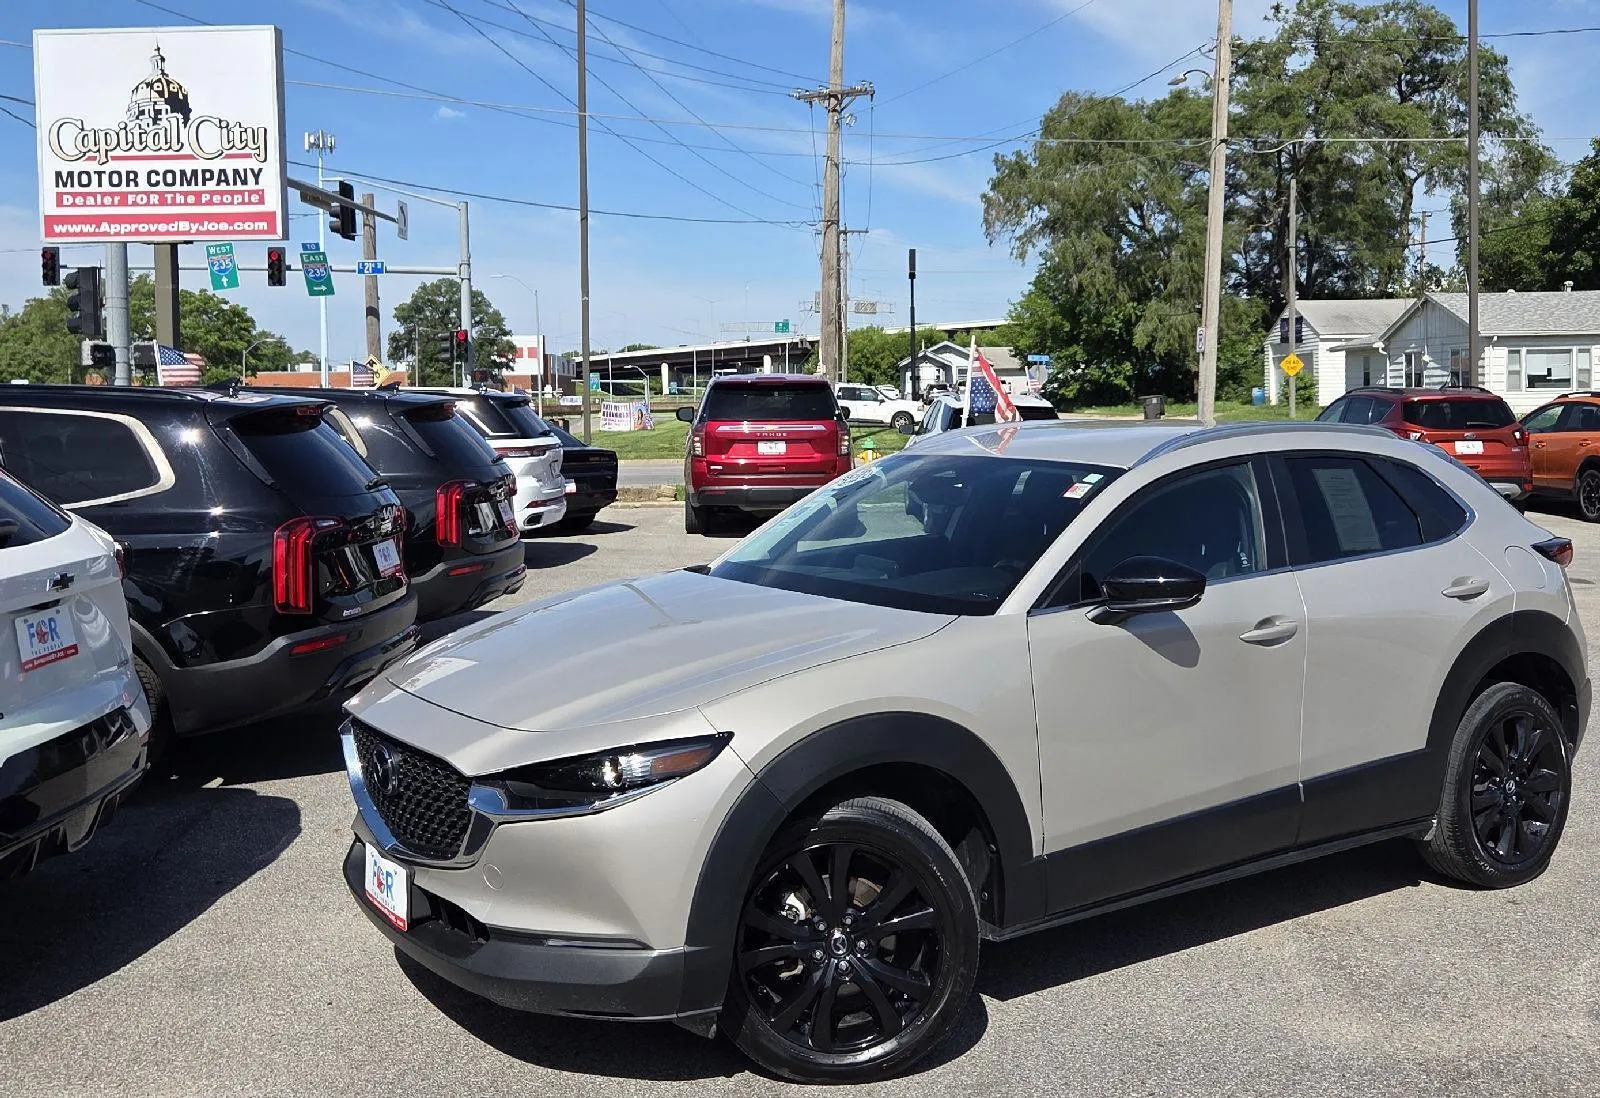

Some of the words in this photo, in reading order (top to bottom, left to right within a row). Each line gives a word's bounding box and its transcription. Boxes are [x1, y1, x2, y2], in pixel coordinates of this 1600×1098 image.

[49, 115, 184, 165] Capital
[188, 115, 267, 162] City
[55, 170, 139, 188] MOTOR
[146, 168, 263, 187] COMPANY
[62, 193, 120, 206] Dealer
[127, 193, 160, 205] FOR
[165, 193, 196, 204] The
[53, 220, 268, 235] www.ApprovedByJoe.com
[213, 260, 232, 270] 235
[307, 267, 327, 277] 235
